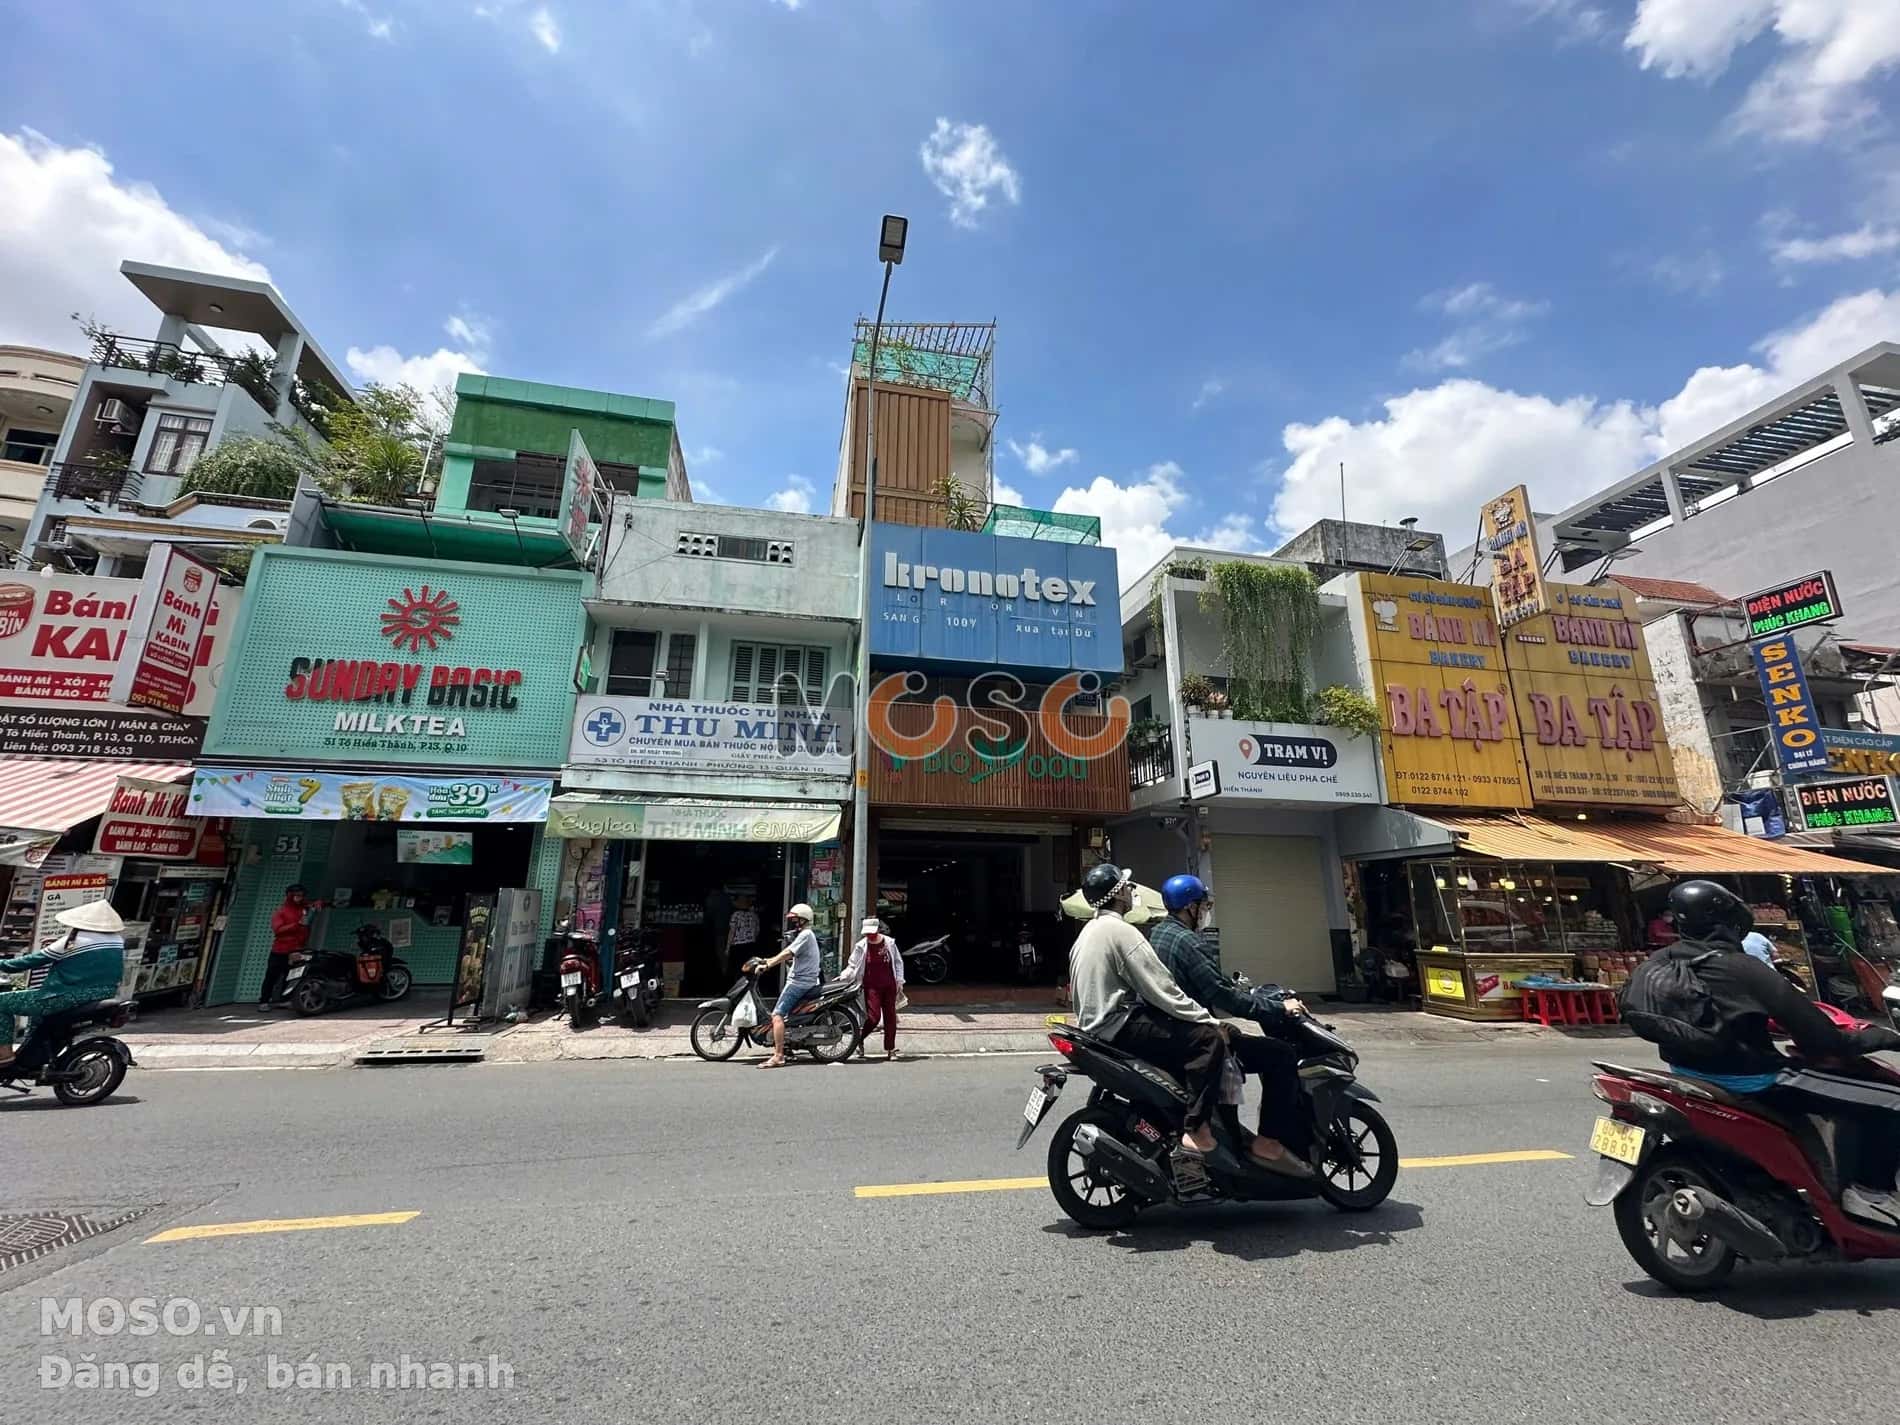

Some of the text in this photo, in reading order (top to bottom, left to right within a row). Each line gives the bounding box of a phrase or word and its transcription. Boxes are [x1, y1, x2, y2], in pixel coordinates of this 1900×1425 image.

[884, 552, 1096, 606] kronotex
[163, 588, 200, 619] Bánh
[1749, 580, 1824, 616] ĐIỆN NƯỚC
[166, 614, 187, 636] Mì
[1408, 608, 1467, 645] BÁNH
[1752, 601, 1830, 634] PHÚC KHANG
[155, 630, 190, 653] KABIN
[15, 685, 80, 698] BÁNH BAO
[36, 676, 52, 685] MÌ
[63, 676, 86, 687] XÔI
[286, 656, 523, 710] SUNDAY BASIC
[1760, 641, 1817, 748] SENKO
[648, 701, 686, 713] NHÀ
[691, 704, 750, 717] THUỐC
[1385, 677, 1508, 752] BA TẬP
[19, 713, 37, 725] SỐ
[39, 717, 81, 728] LƯỢNG
[83, 716, 108, 728] LỚN
[150, 722, 158, 730] &
[634, 714, 841, 743] THU MINH
[1528, 684, 1657, 763] BA TẬP
[7, 728, 18, 737] Tô
[52, 730, 90, 741] Thành,
[93, 731, 121, 743] P.13,
[124, 734, 155, 745] Q.10,
[323, 737, 335, 746] 51
[380, 739, 417, 750] Thành,
[444, 742, 467, 754] Q.10
[628, 735, 672, 747] CHUYÊN
[674, 738, 697, 748] MUA
[699, 738, 720, 749] BÁN
[723, 740, 757, 750] THUỐC
[1854, 738, 1875, 746] CAO
[3, 741, 134, 755] Liên hệ: 093 718 5633
[1263, 743, 1328, 765] TRẠM VỊ
[1238, 770, 1339, 784] NGUYÊN LIỆU PHA CHẾ
[109, 785, 148, 816] Bánh
[299, 778, 321, 804] 7
[1411, 785, 1432, 794] 0122
[1801, 780, 1888, 808] ĐIỆN NƯỚC
[558, 815, 638, 835] Eugica
[275, 835, 301, 854] 51
[44, 879, 70, 888] BÁNH
[47, 893, 61, 901] GÀ
[1135, 1117, 1161, 1143] YSS
